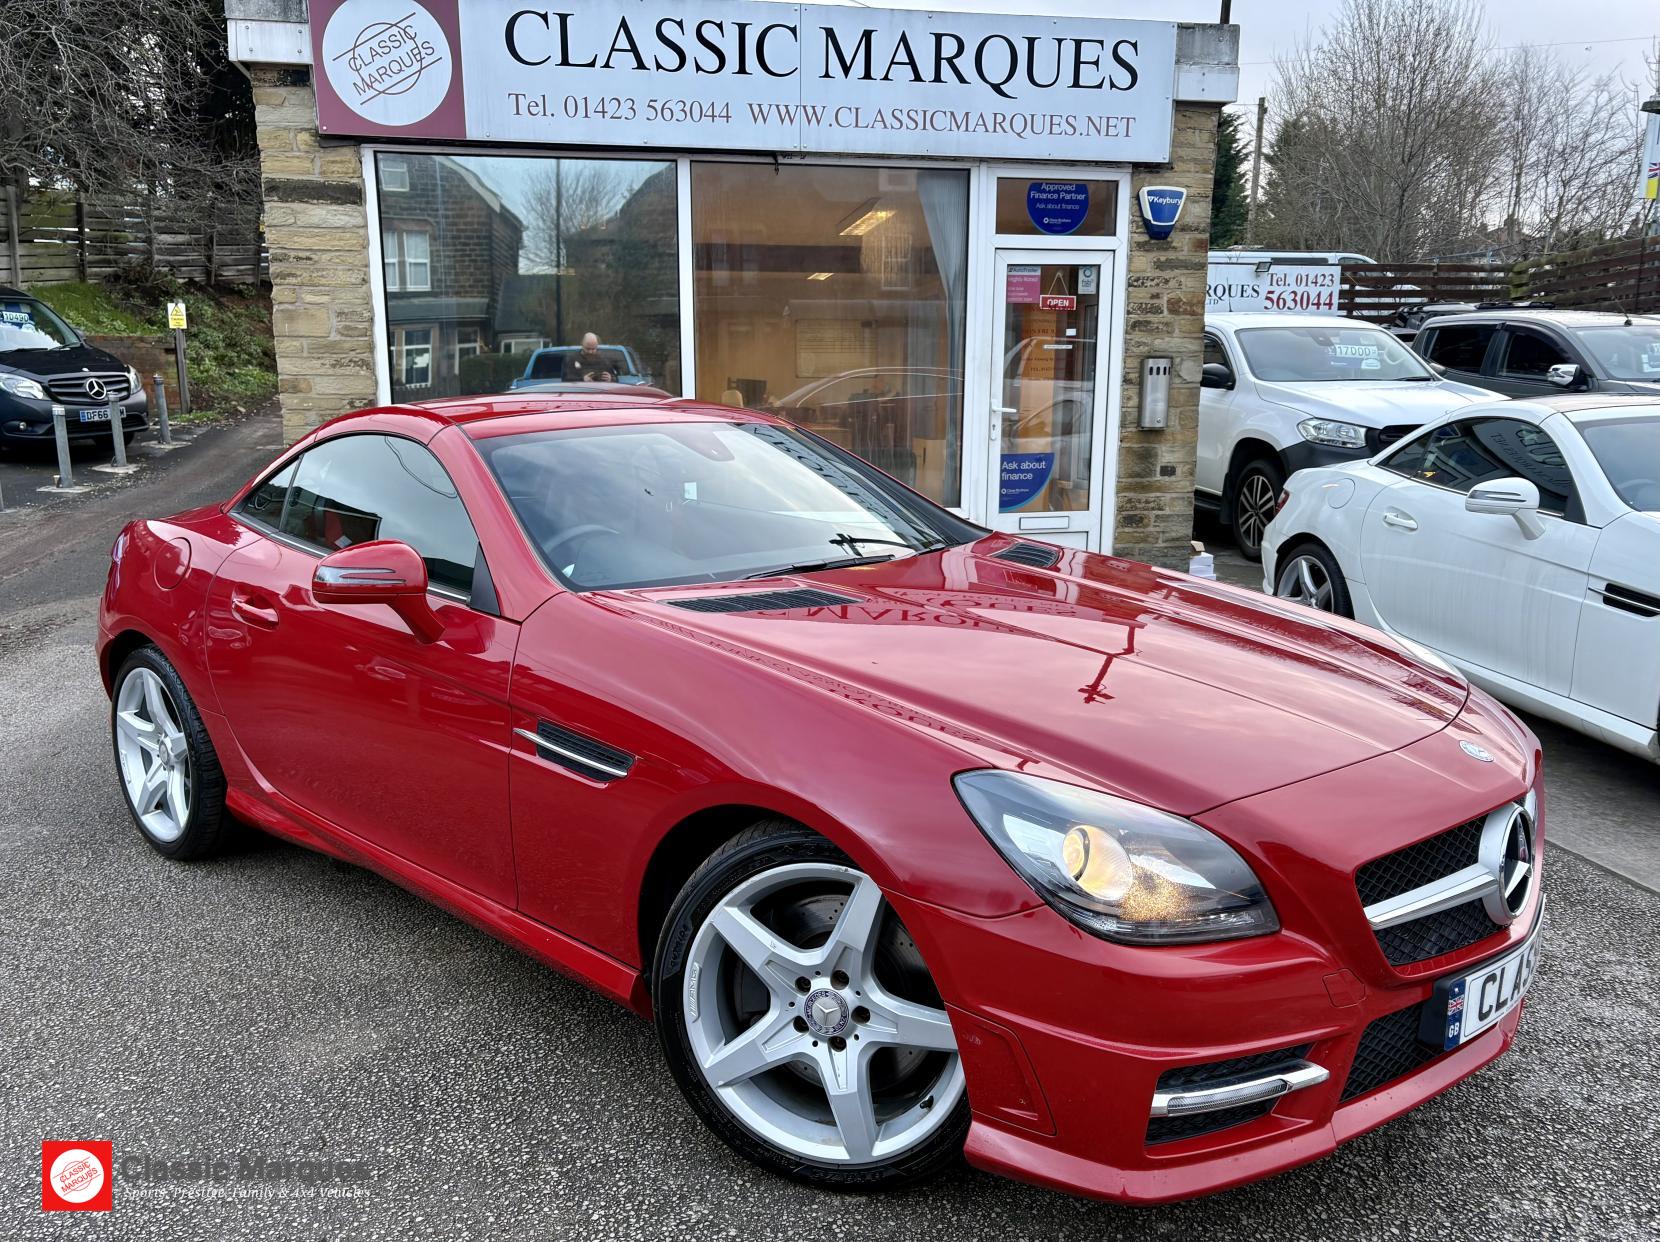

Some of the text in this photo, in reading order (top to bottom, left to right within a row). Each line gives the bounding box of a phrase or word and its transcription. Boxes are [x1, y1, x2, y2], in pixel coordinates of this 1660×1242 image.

[348, 25, 417, 72] CLASSIC
[504, 10, 1139, 99] CLASSIC MARQUES
[352, 41, 435, 95] MARQUES
[508, 93, 1136, 140] Tel. 01423 563044 WWW.CLASSICMARQUES.NET
[1041, 183, 1076, 191] Approved
[1030, 191, 1086, 200] Finance Partner
[1153, 196, 1182, 206] Keybury
[1267, 273, 1335, 287] Tel. 01423
[1047, 300, 1070, 308] OPEN
[1263, 290, 1334, 311] 563044
[1001, 460, 1046, 470] Ask about
[1001, 471, 1033, 480] finance
[1448, 1022, 1460, 1038] GB
